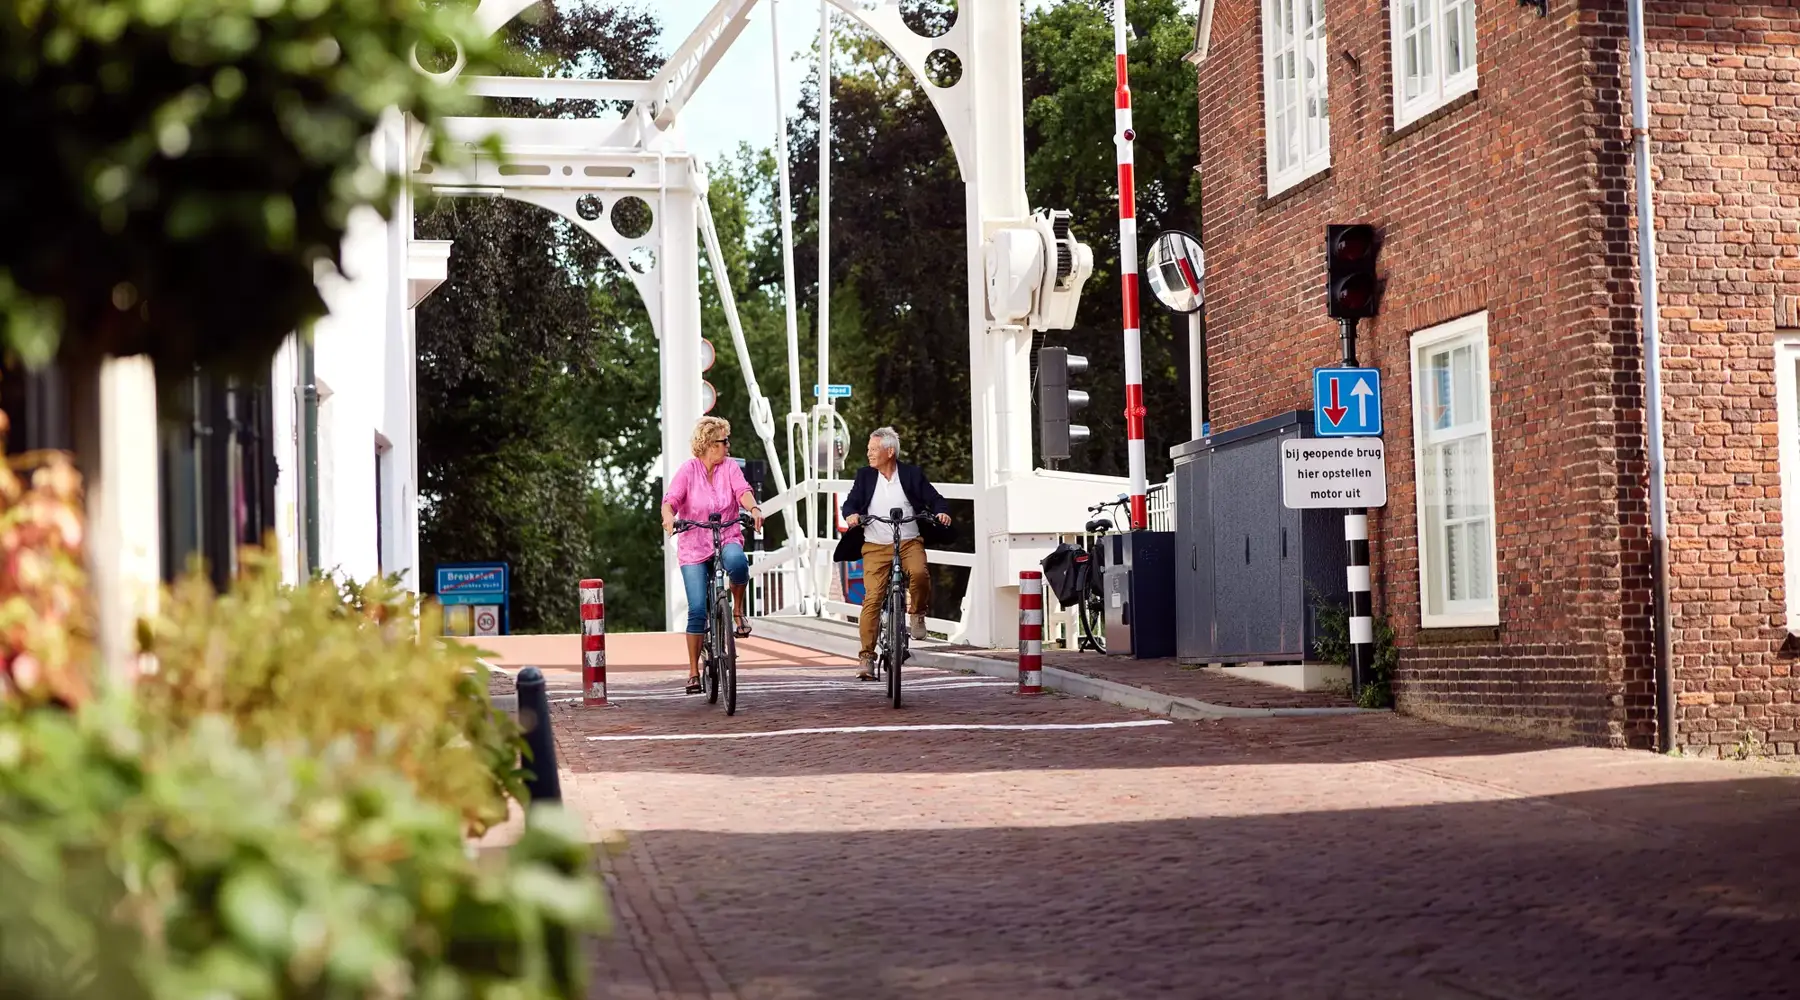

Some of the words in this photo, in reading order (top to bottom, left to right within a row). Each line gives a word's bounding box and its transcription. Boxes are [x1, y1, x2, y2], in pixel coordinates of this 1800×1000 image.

[1286, 449, 1299, 461] bij
[1303, 448, 1353, 461] geopende
[1357, 448, 1381, 460] brug
[1297, 469, 1319, 479] hier
[1322, 468, 1372, 480] opstellen
[1310, 489, 1342, 499] motor
[1345, 488, 1361, 498] uit
[480, 617, 493, 626] 30
